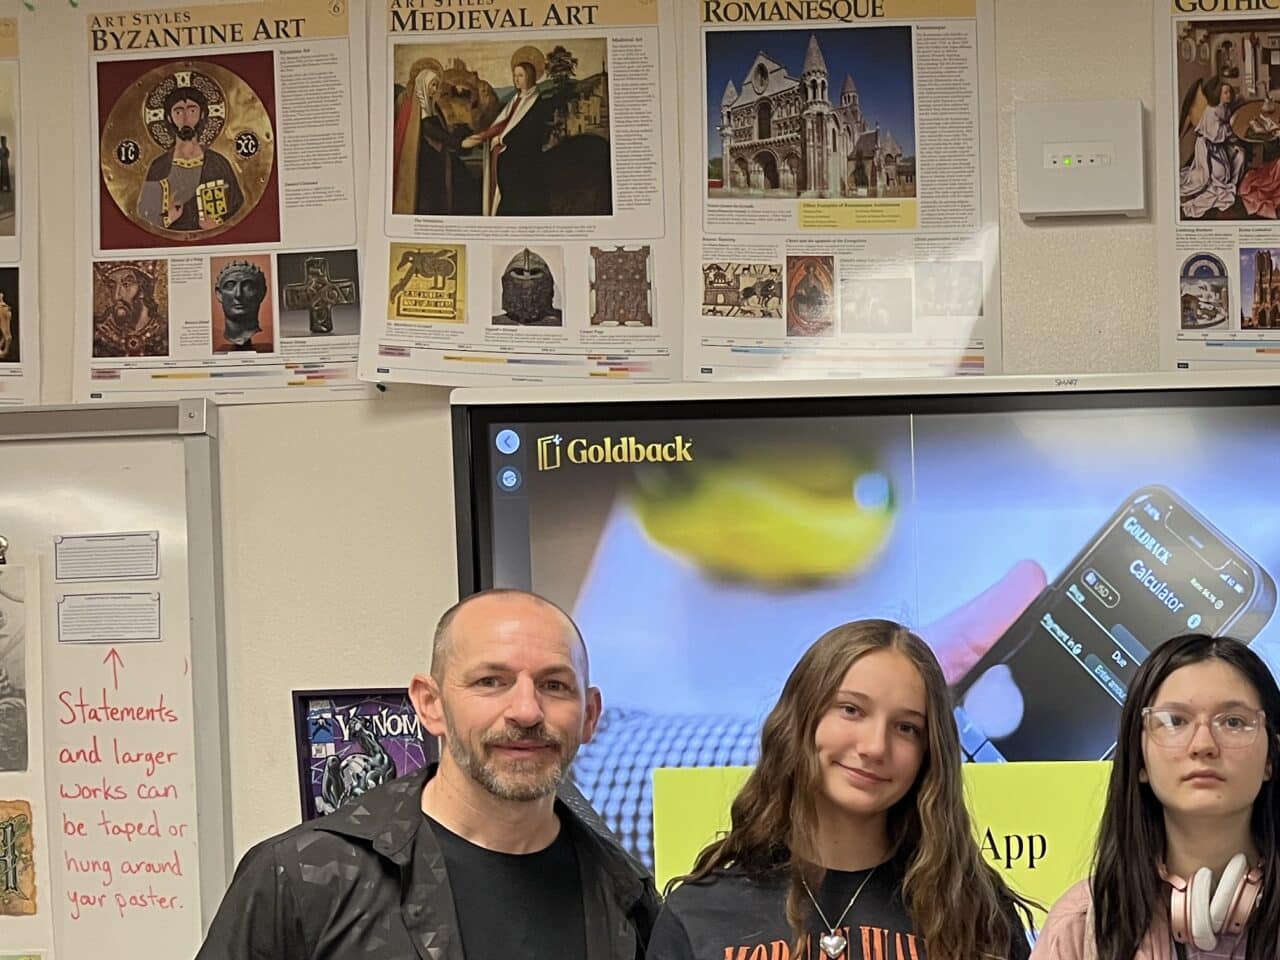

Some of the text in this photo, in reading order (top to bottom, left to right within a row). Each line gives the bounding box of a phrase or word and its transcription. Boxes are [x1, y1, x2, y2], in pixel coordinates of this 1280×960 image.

[91, 11, 192, 28] ART STYLES
[390, 4, 599, 32] MEDIEVAL ART
[703, 0, 885, 22] ROMANESQUE
[91, 18, 306, 51] BYZANTINE ART
[566, 434, 693, 465] Goldback
[1128, 559, 1185, 613] Calculator
[1111, 649, 1128, 668] Due
[58, 687, 179, 725] Statements
[335, 706, 424, 742] VNOM
[58, 735, 179, 777] and larger
[59, 782, 179, 801] works can
[63, 810, 189, 847] be taped or
[980, 826, 1047, 869] App
[64, 850, 184, 887] hung around
[67, 887, 185, 919] your poster.
